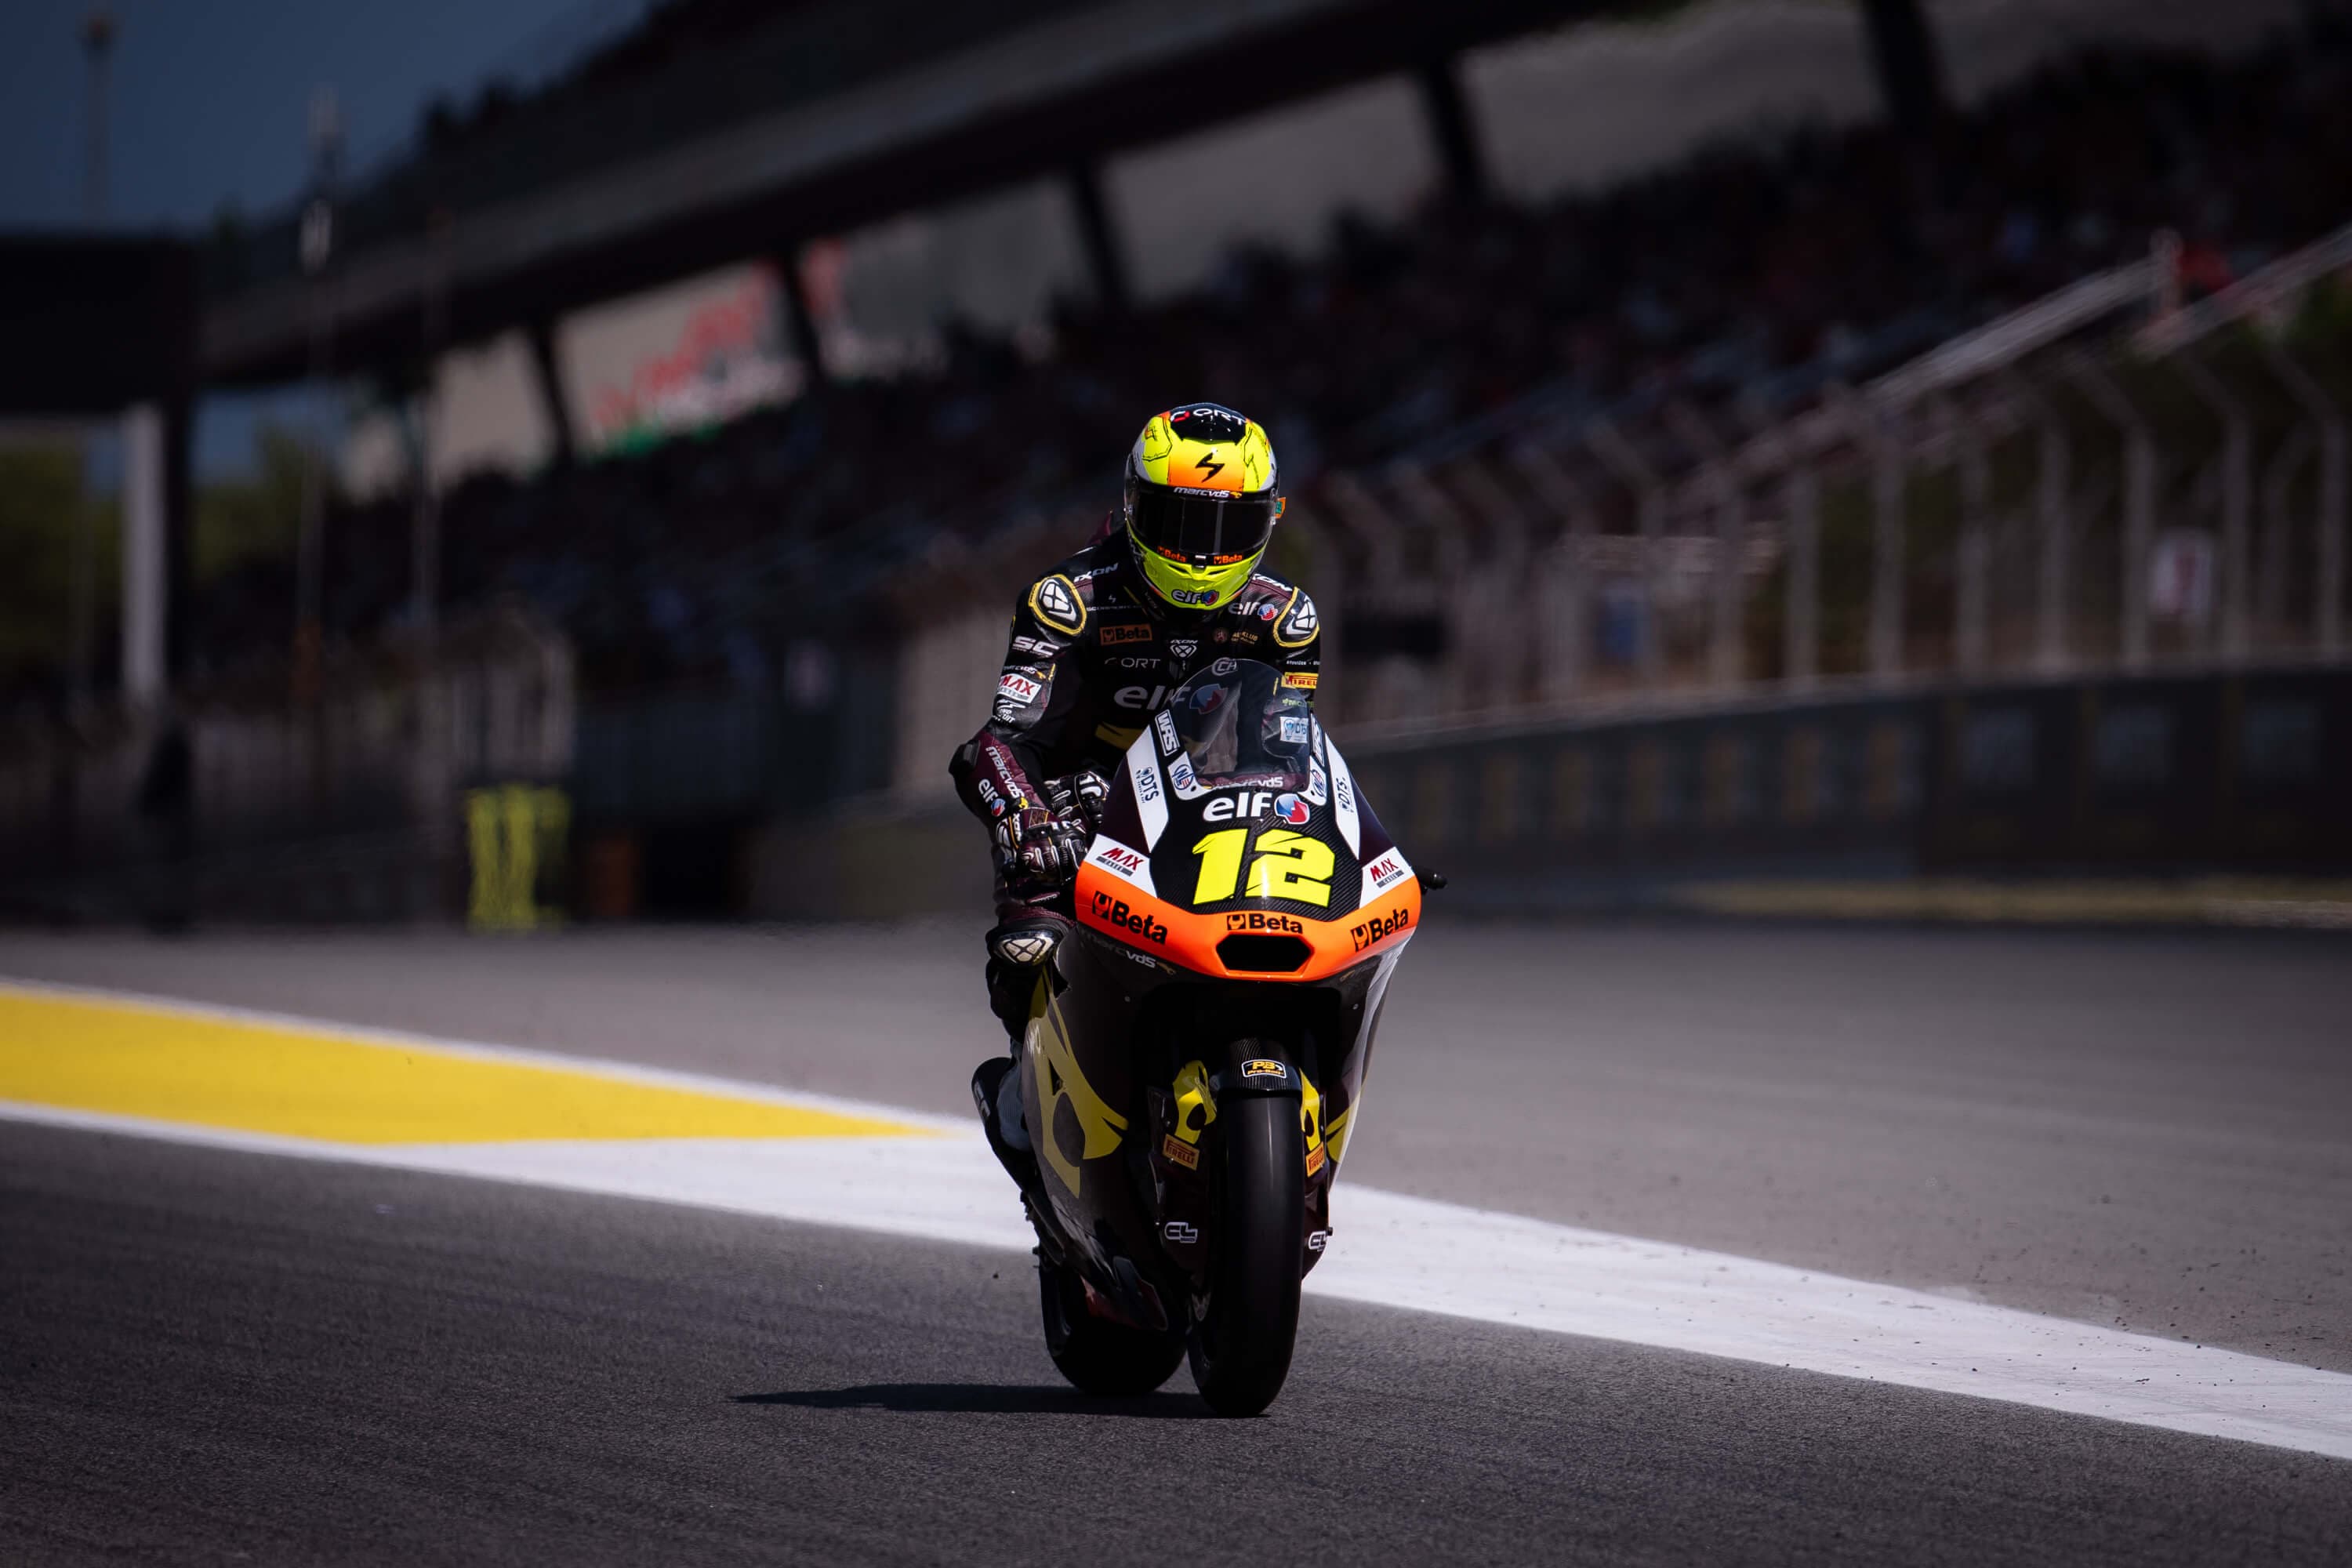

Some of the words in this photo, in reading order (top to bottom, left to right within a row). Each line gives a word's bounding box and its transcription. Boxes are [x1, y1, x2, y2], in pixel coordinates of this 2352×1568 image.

[1164, 548, 1187, 563] Beta
[1222, 554, 1243, 564] Beta
[1074, 562, 1119, 583] IXON
[1172, 590, 1202, 604] elf
[1229, 601, 1261, 615] elf
[1116, 627, 1150, 640] Beta
[1000, 675, 1035, 696] MAX
[1113, 684, 1192, 710] elf
[1156, 712, 1178, 753] WRS
[978, 779, 998, 804] elf
[1141, 774, 1159, 801] DTS
[1203, 792, 1272, 822] elf
[1102, 847, 1144, 871] MAX
[1192, 829, 1335, 908] 12
[1370, 858, 1399, 882] MAX
[1110, 898, 1168, 945] Beta
[1250, 913, 1303, 934] Beta
[1370, 908, 1409, 942] Beta
[1166, 1139, 1196, 1165] PIRELLI
[1308, 1145, 1324, 1172] PIRELLI
